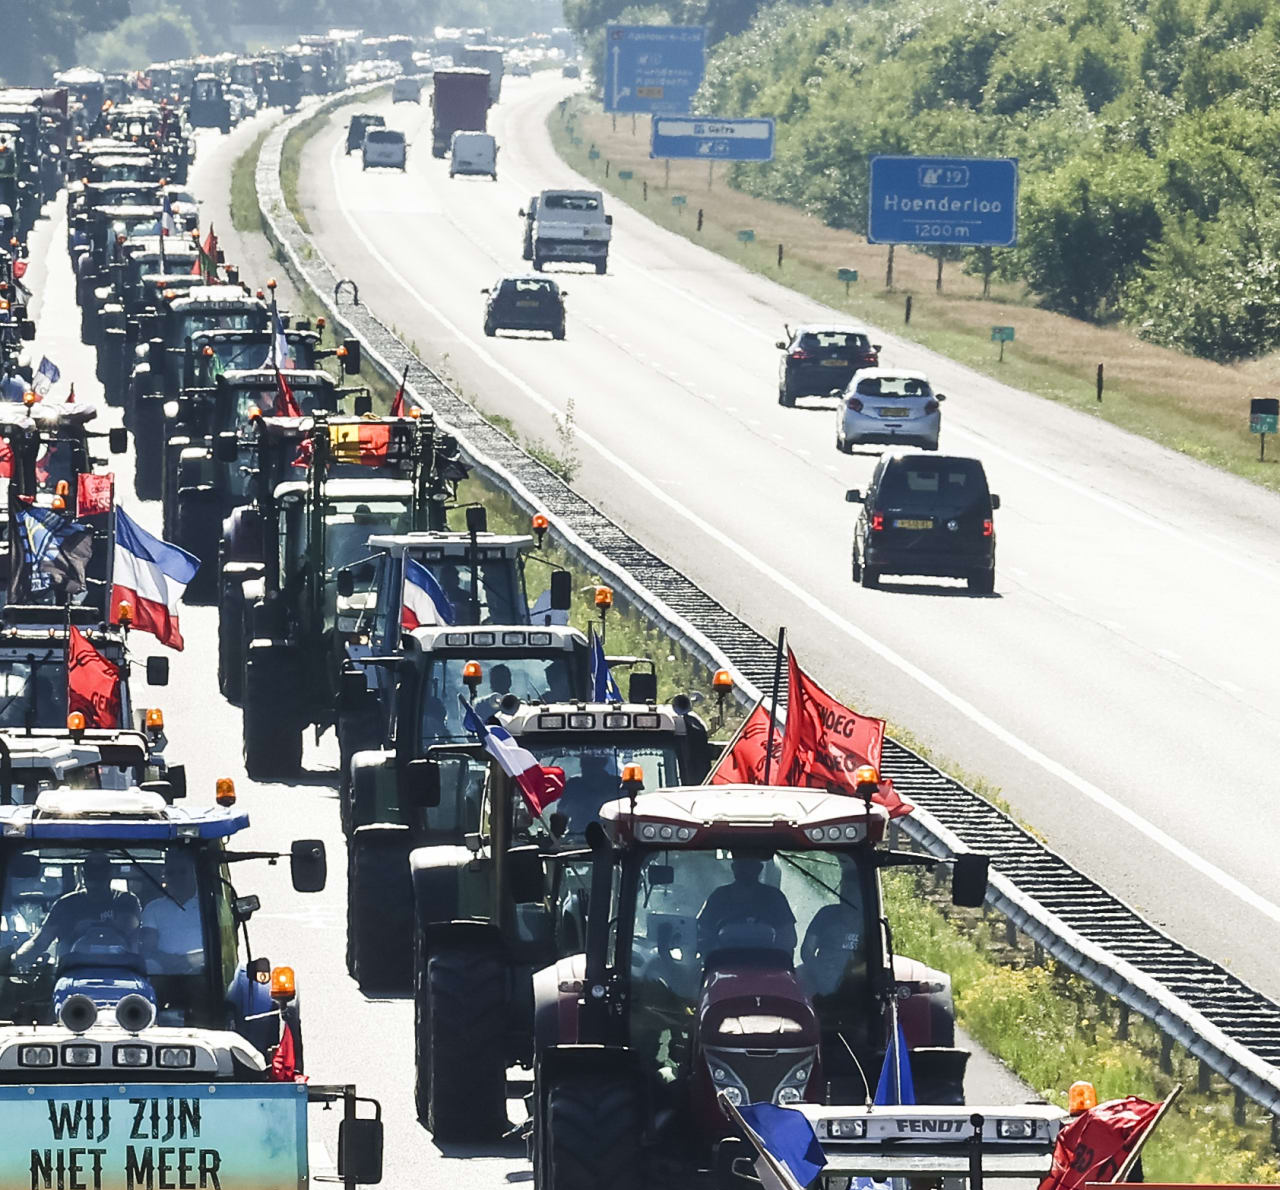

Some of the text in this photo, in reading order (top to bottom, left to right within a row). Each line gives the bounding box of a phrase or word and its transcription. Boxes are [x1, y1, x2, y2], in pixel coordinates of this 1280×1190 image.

[945, 170, 962, 183] 19
[884, 194, 1001, 213] Hoenderloo
[47, 1097, 202, 1143] WIJ ZIJN
[896, 1119, 967, 1133] FENDT
